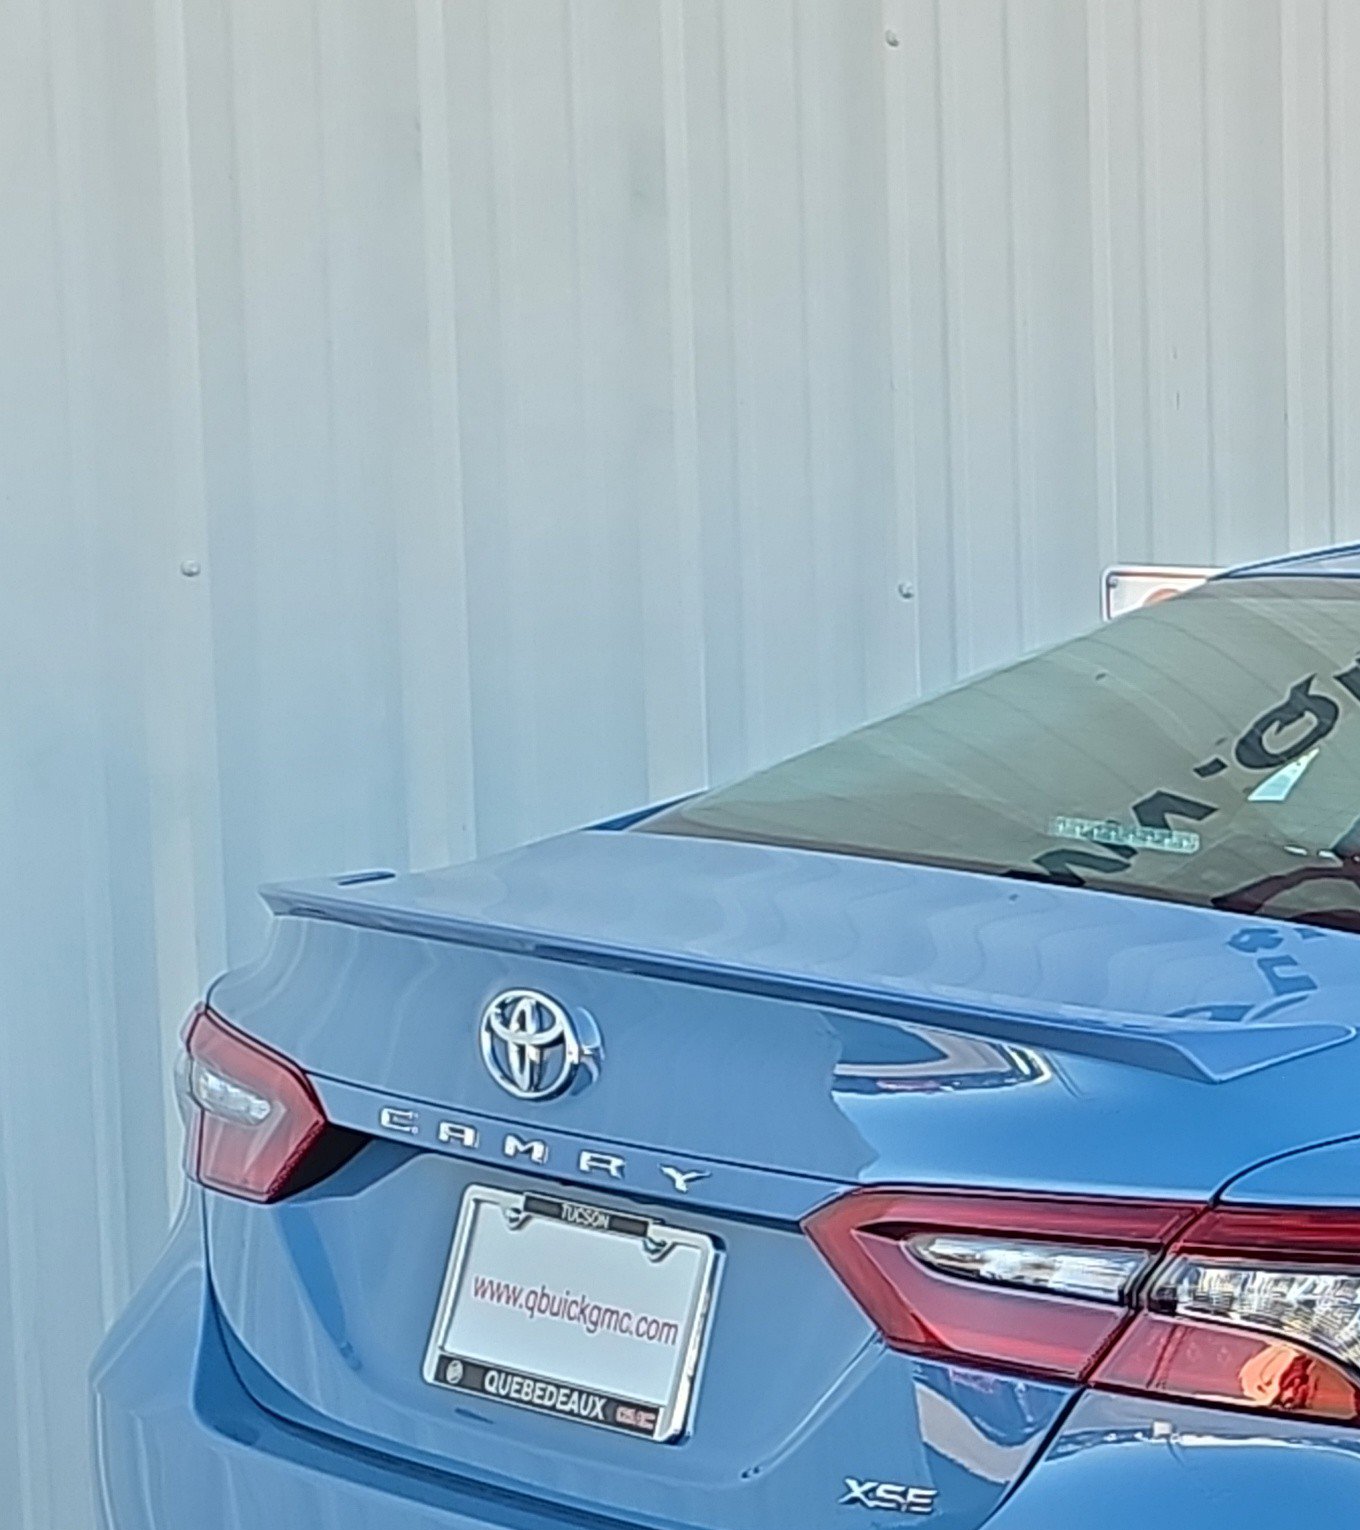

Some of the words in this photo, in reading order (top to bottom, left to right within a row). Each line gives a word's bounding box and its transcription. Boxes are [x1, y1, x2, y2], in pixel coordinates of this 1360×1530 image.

[380, 1107, 712, 1193] CAMRY
[560, 1202, 611, 1230] TUCSON
[472, 1274, 679, 1346] www.qbuickgmc.com
[483, 1369, 608, 1421] QUEBEDEAUX
[837, 1477, 939, 1515] XSE
